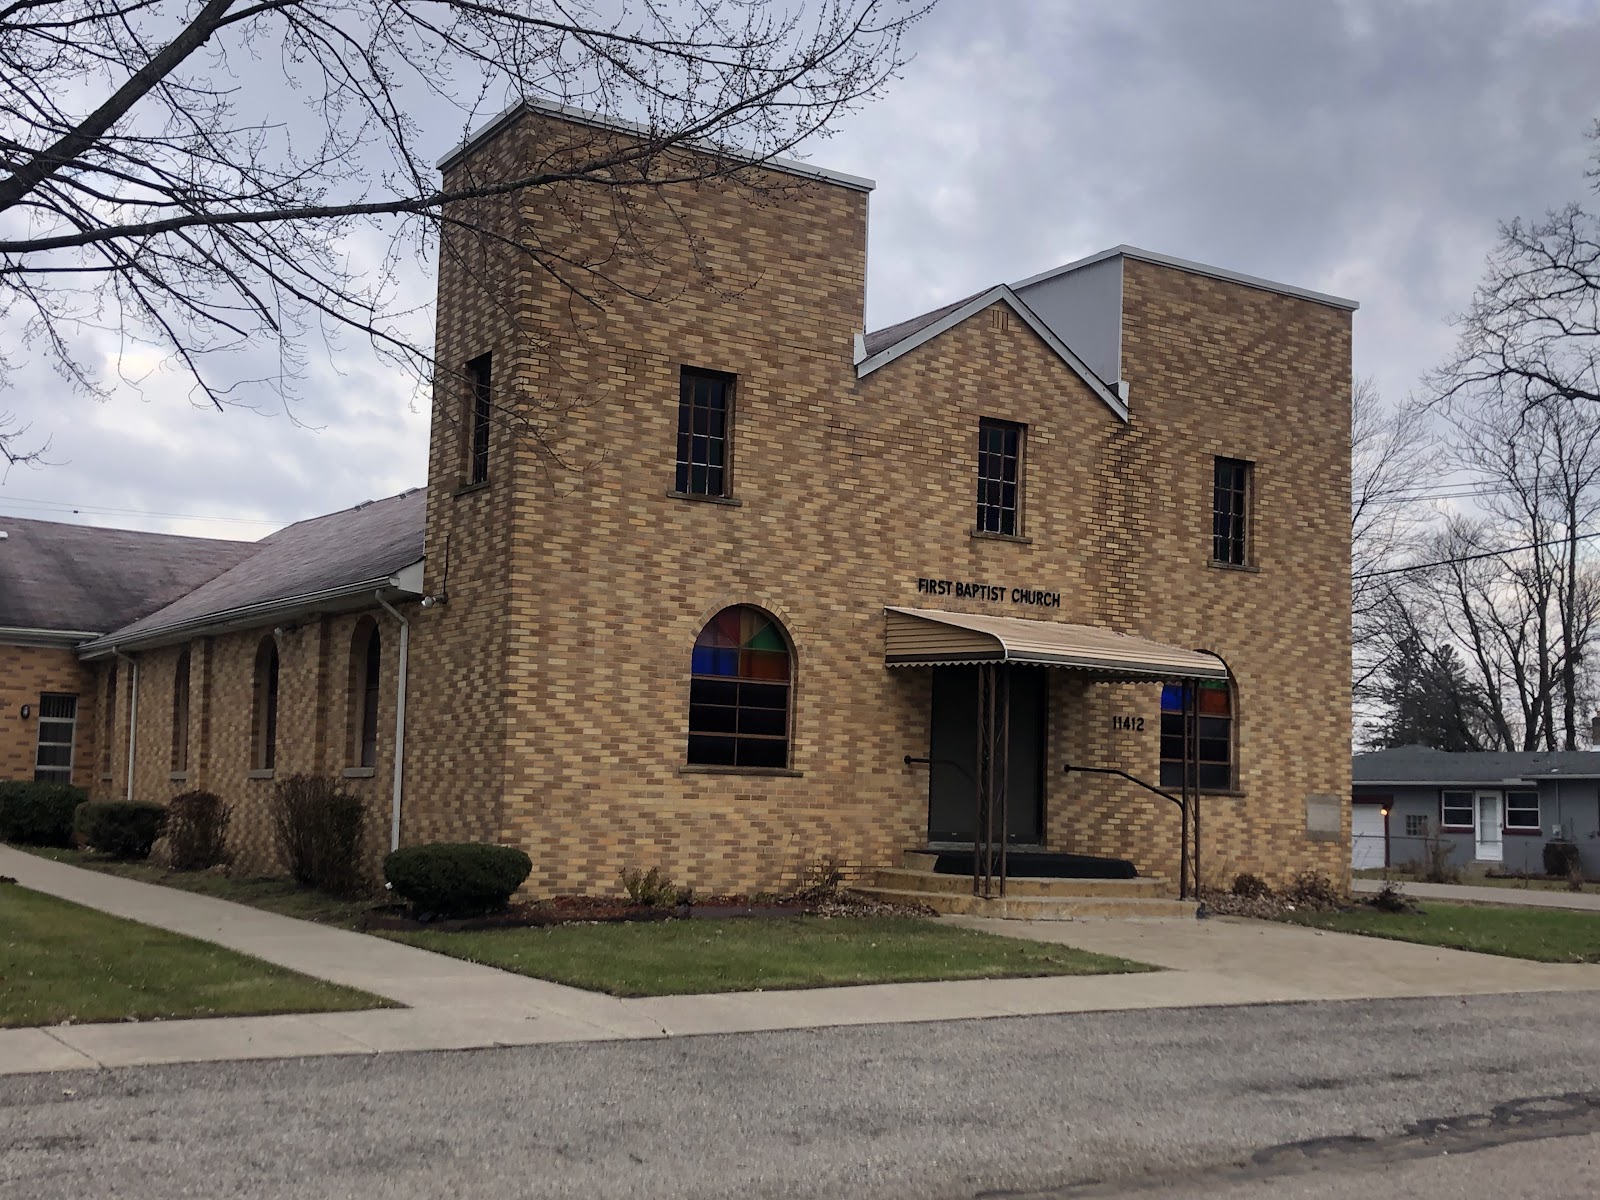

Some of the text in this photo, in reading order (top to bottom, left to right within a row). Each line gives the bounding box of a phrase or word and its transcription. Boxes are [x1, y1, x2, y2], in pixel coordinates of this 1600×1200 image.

[918, 578, 1061, 608] FIRST BAPTIST CHURCH
[1112, 715, 1145, 731] 11412
